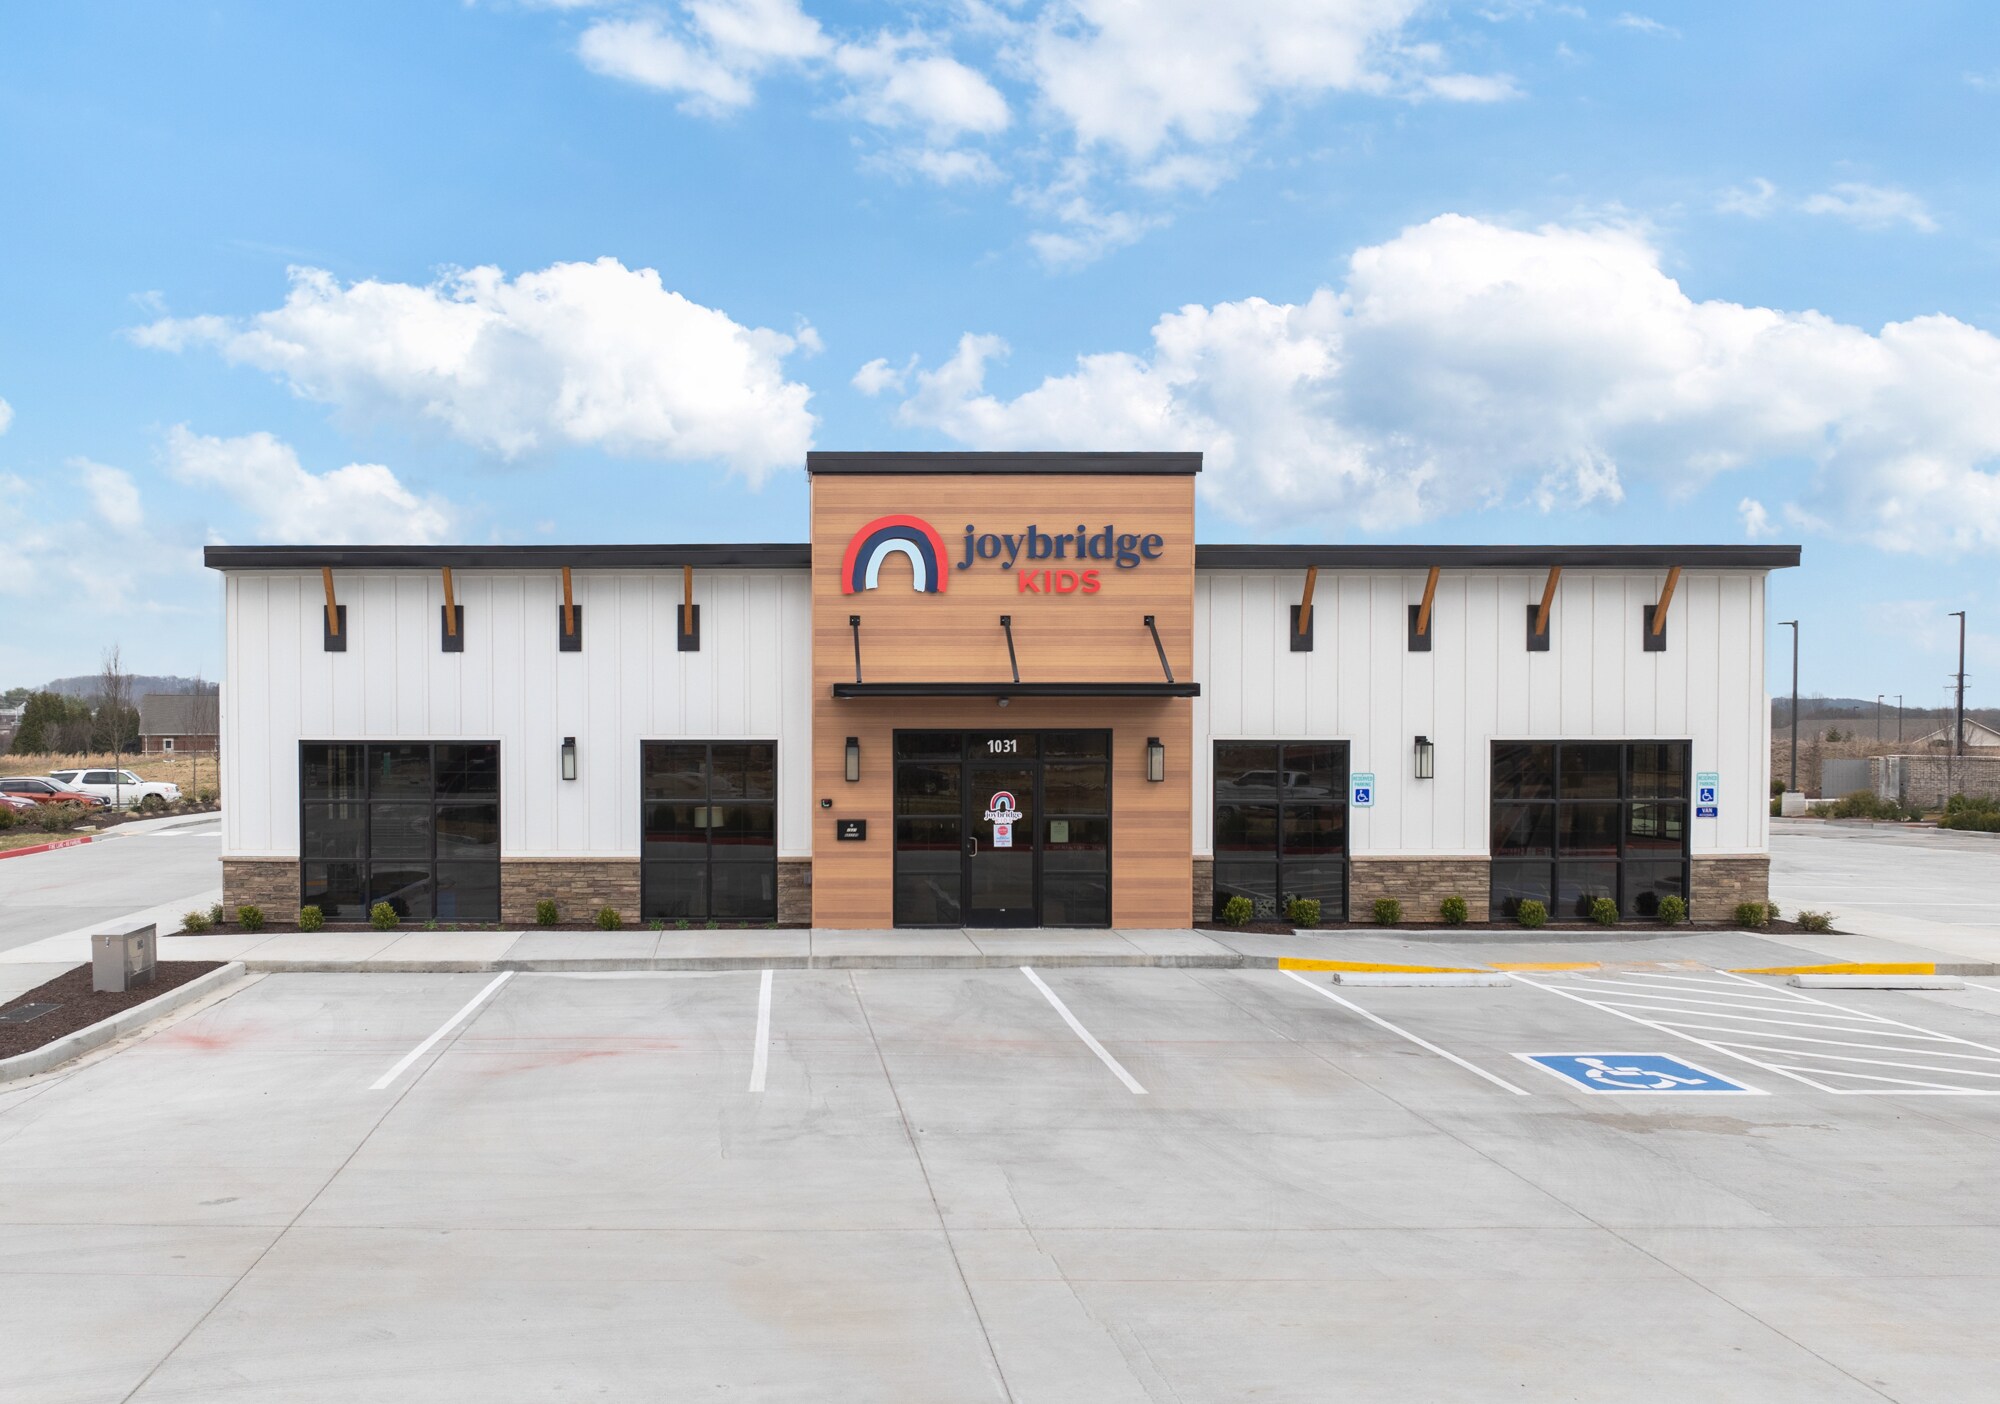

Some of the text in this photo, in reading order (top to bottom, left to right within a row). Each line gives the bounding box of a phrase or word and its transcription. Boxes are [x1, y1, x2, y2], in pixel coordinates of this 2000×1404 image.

[957, 524, 1164, 569] joybridge
[1018, 569, 1101, 593] KIDS
[987, 740, 1017, 753] 1031
[985, 810, 1021, 820] joybridge
